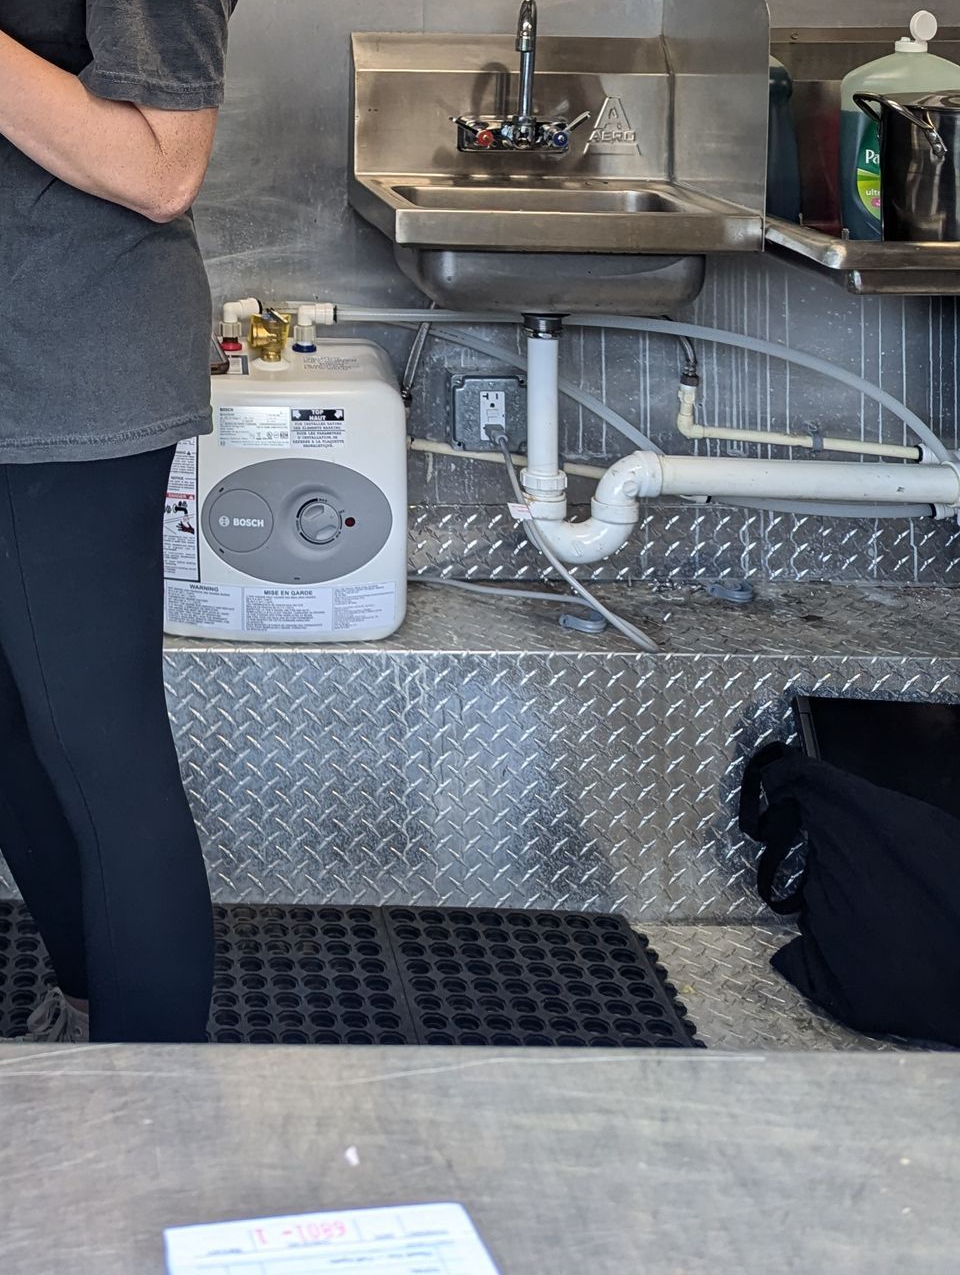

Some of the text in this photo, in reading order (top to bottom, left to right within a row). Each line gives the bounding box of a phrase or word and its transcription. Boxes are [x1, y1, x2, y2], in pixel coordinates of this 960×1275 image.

[589, 130, 636, 143] AERO
[233, 518, 264, 528] BOSCH
[189, 584, 219, 592] WARNING
